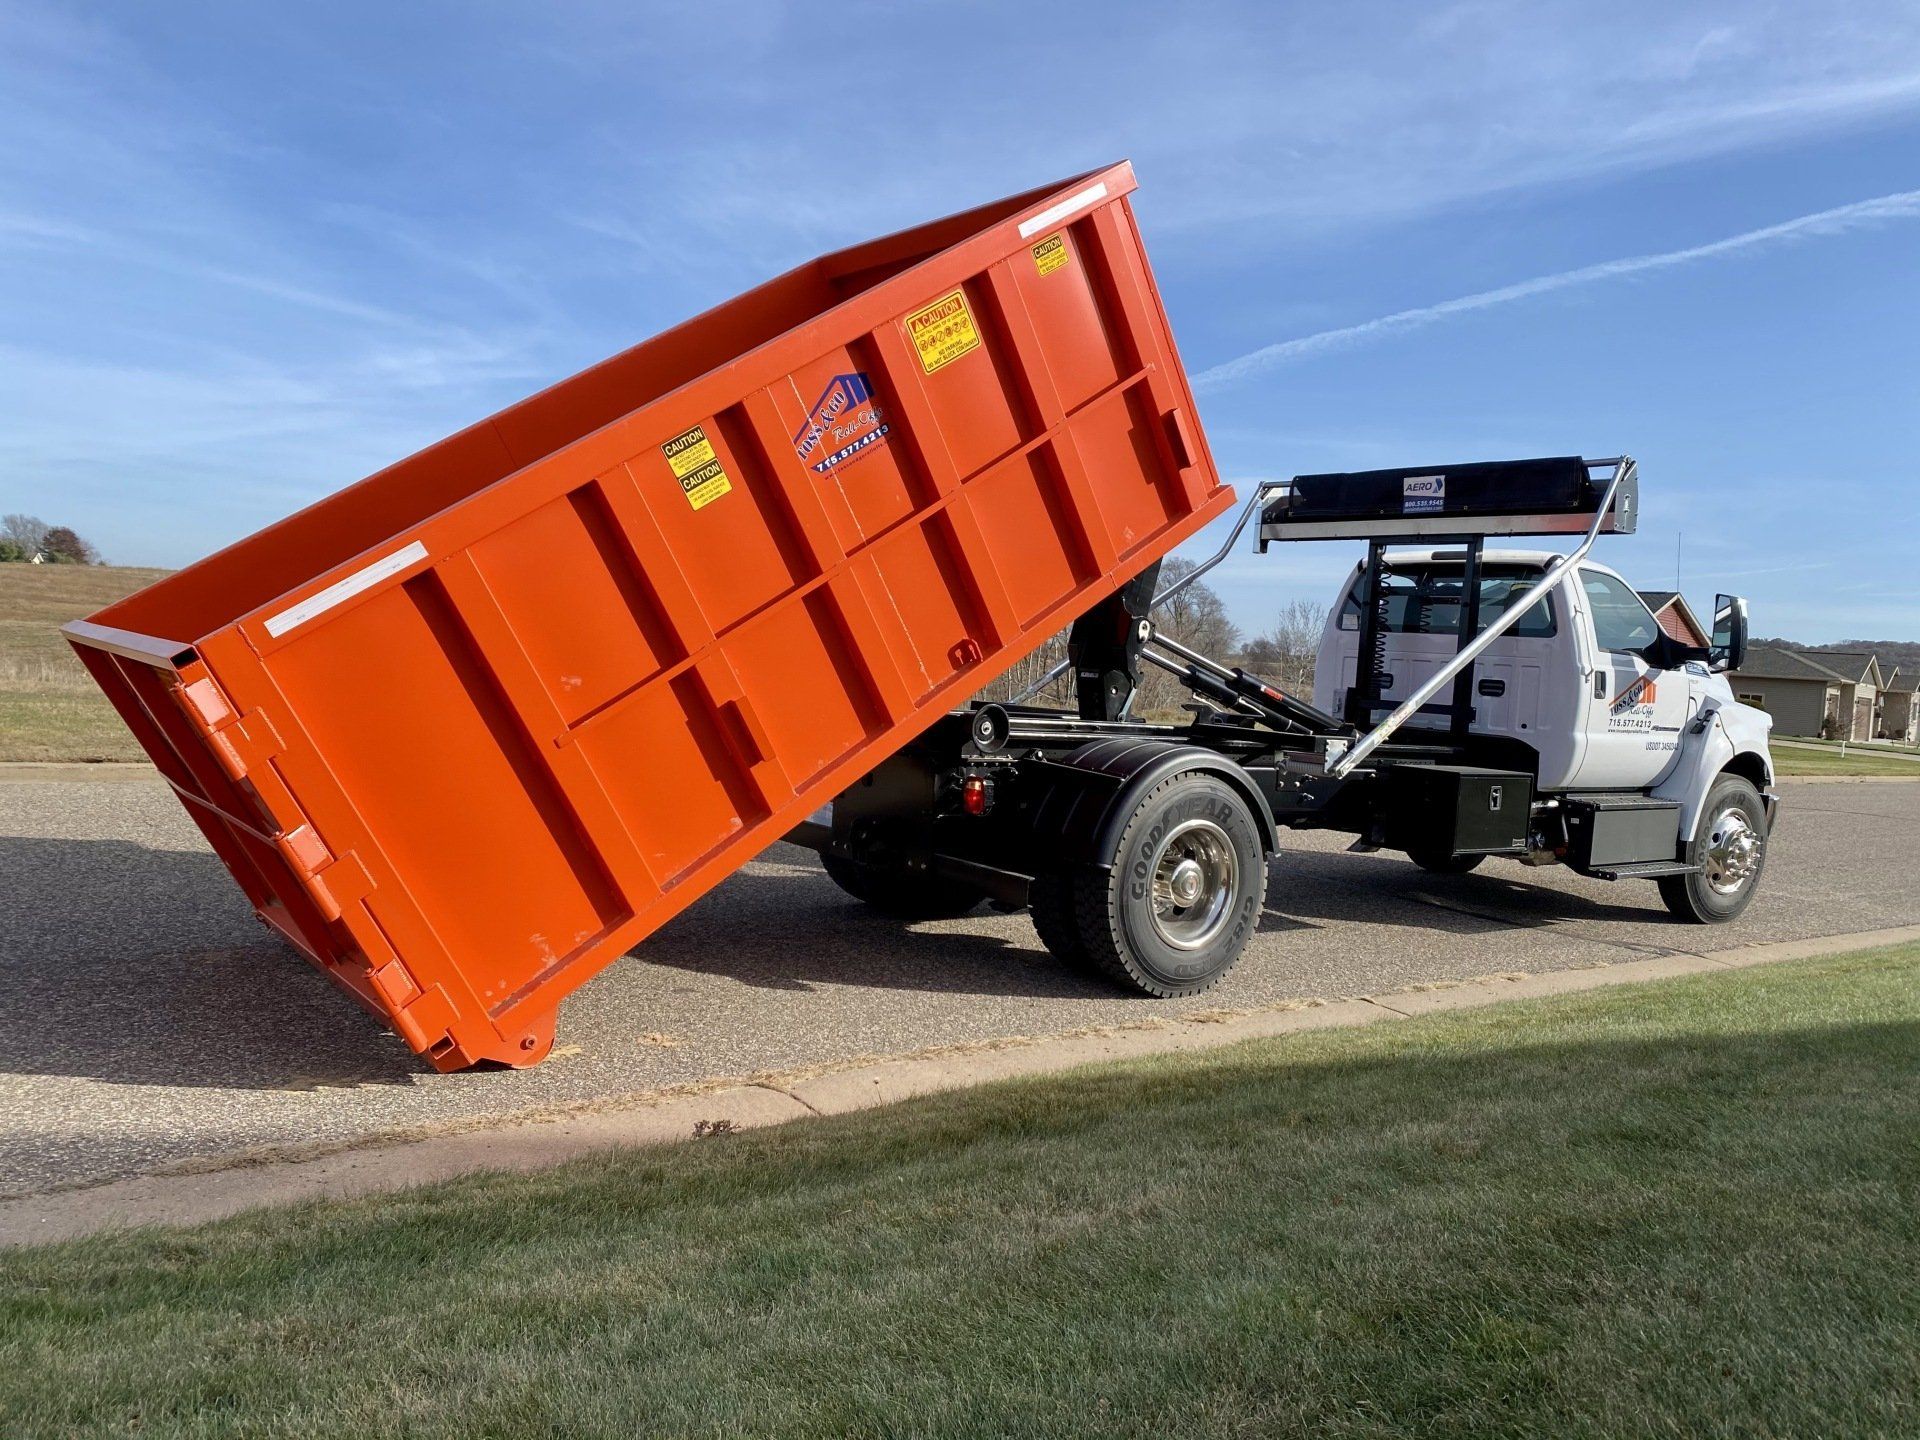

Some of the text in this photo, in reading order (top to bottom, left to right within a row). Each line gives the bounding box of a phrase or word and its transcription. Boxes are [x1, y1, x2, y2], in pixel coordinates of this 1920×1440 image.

[1034, 237, 1061, 258] CAUTION
[921, 299, 959, 327] CAUTION
[664, 428, 704, 456] CAUTION
[816, 424, 889, 473] 715.577.4213
[682, 462, 721, 490] CAUTION
[1405, 482, 1433, 492] AERO
[1609, 718, 1652, 729] 715.577.4213
[1131, 797, 1233, 901] GOODYEAR
